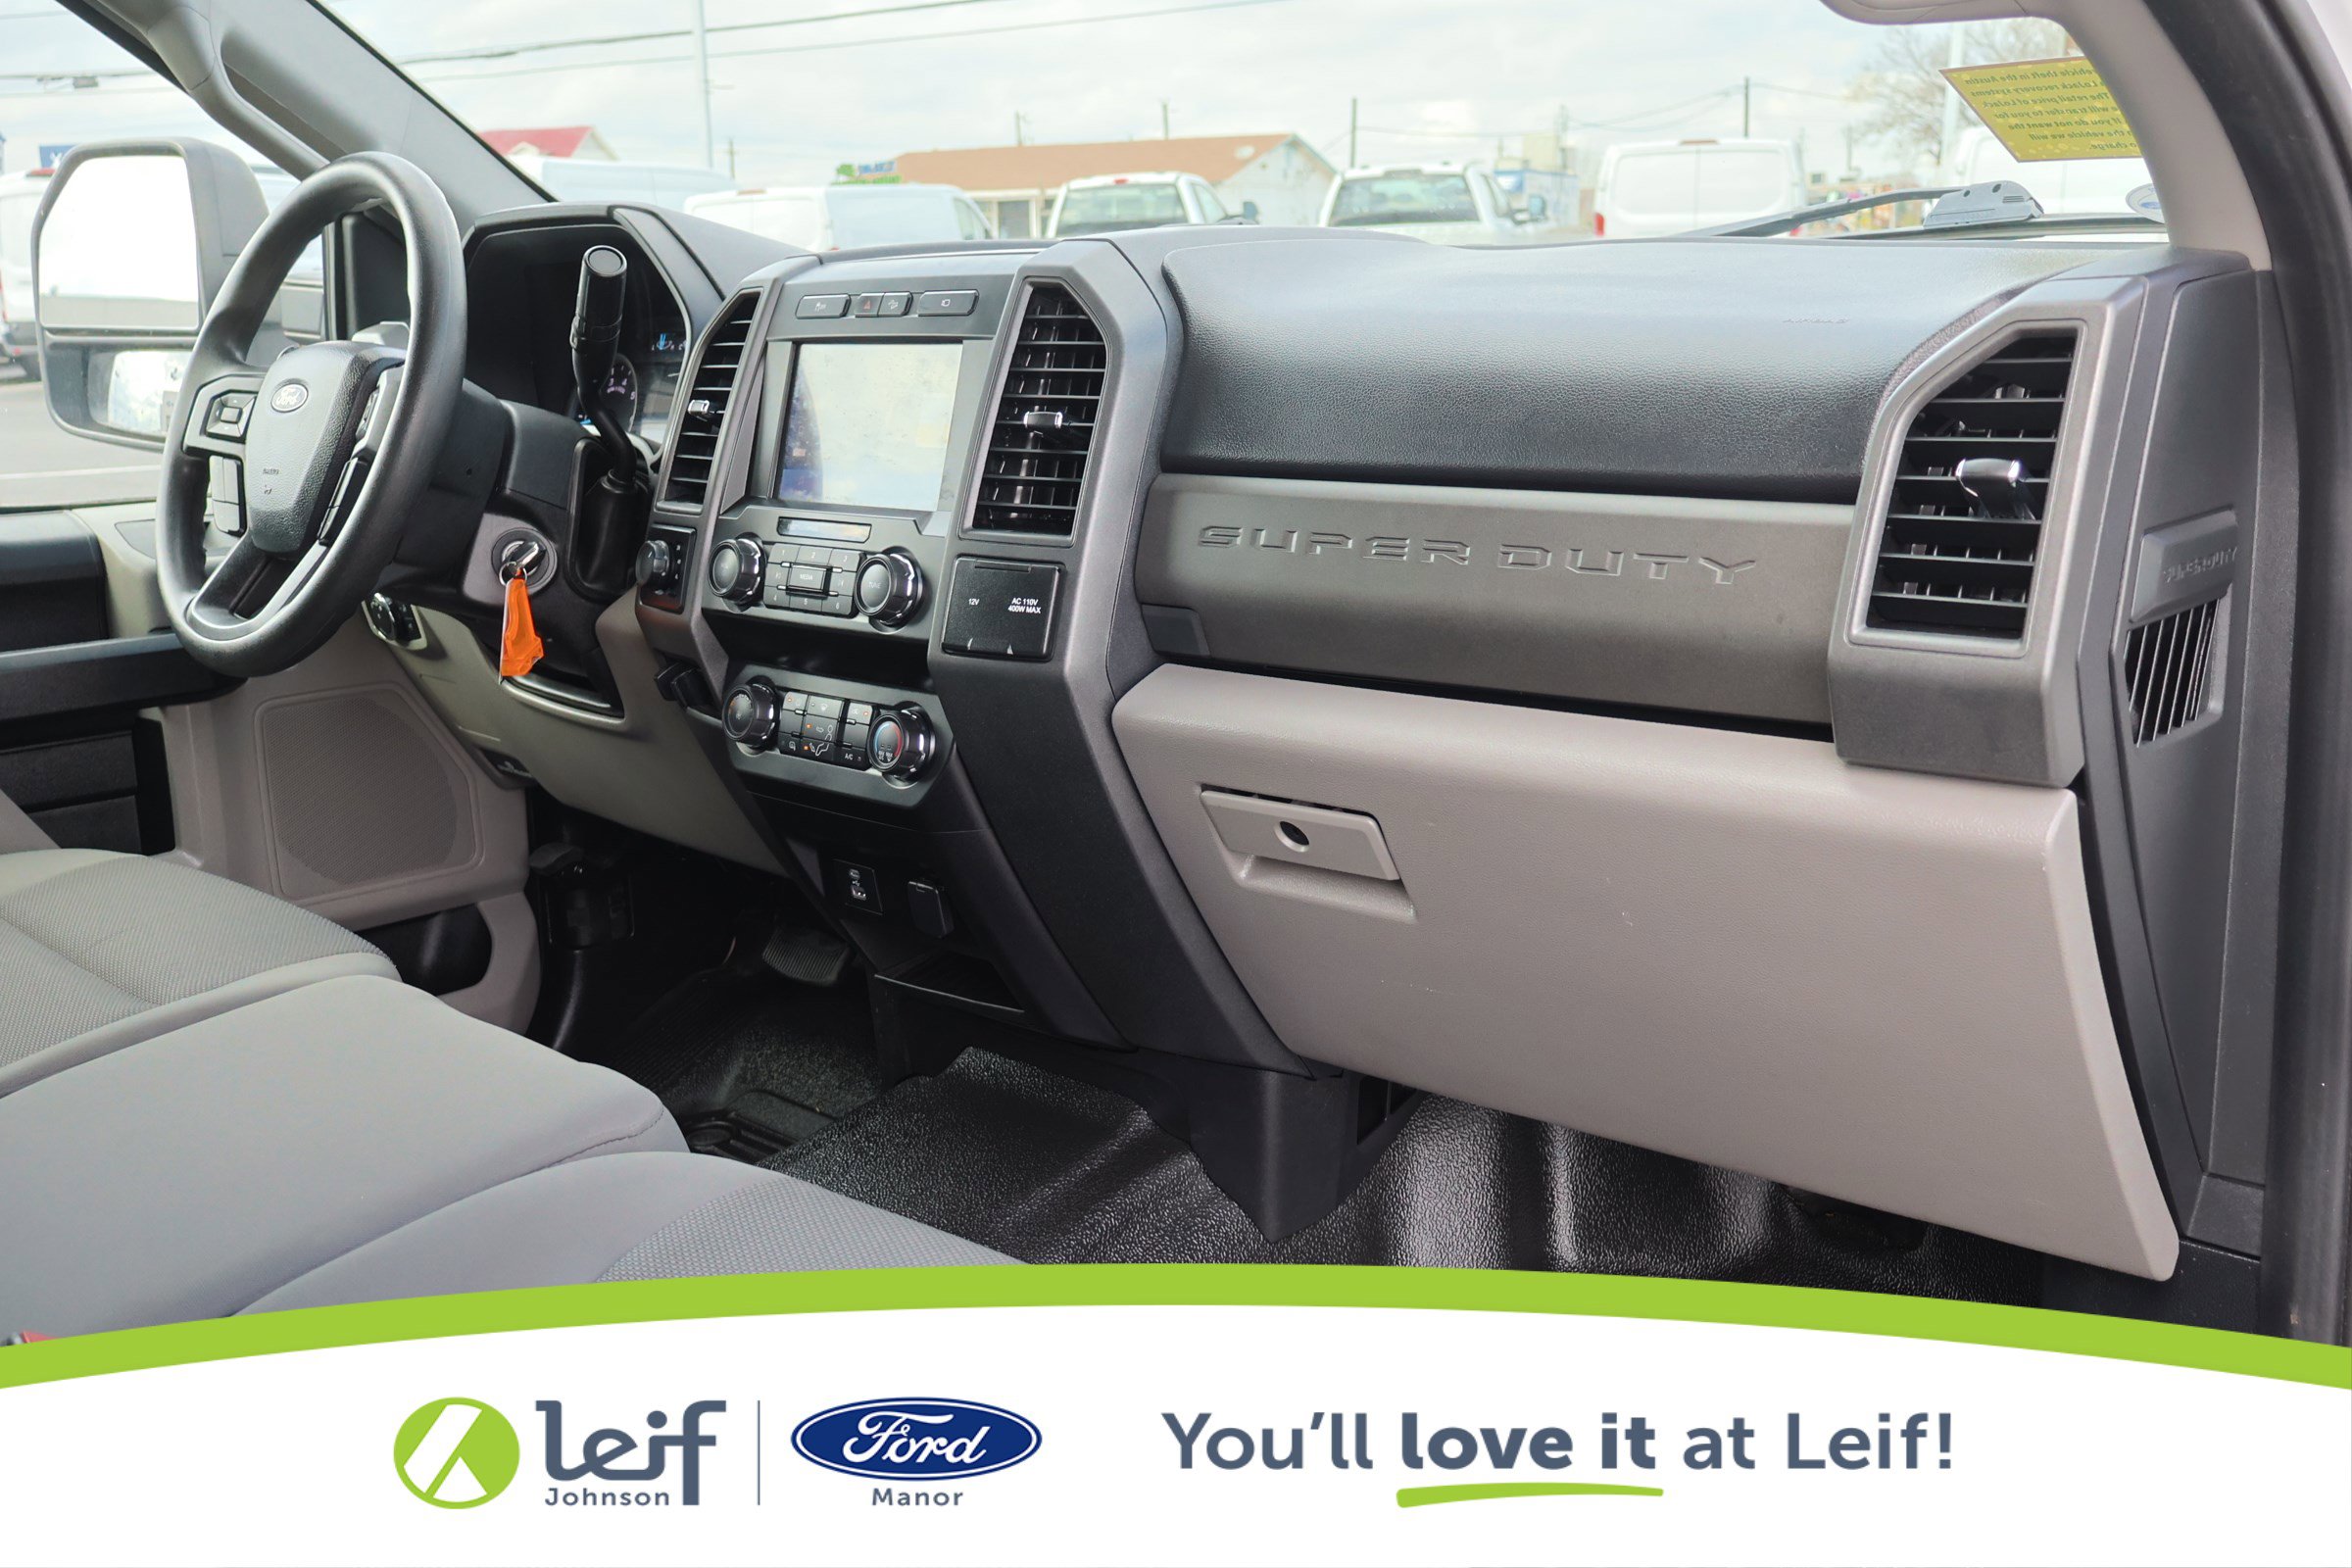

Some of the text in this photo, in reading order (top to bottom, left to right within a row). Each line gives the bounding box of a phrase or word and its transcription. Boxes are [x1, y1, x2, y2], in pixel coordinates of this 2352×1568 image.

[1198, 524, 1757, 585] SUPER DUTY
[1022, 598, 1039, 607] 110V
[1007, 605, 1042, 614] 400W MAX
